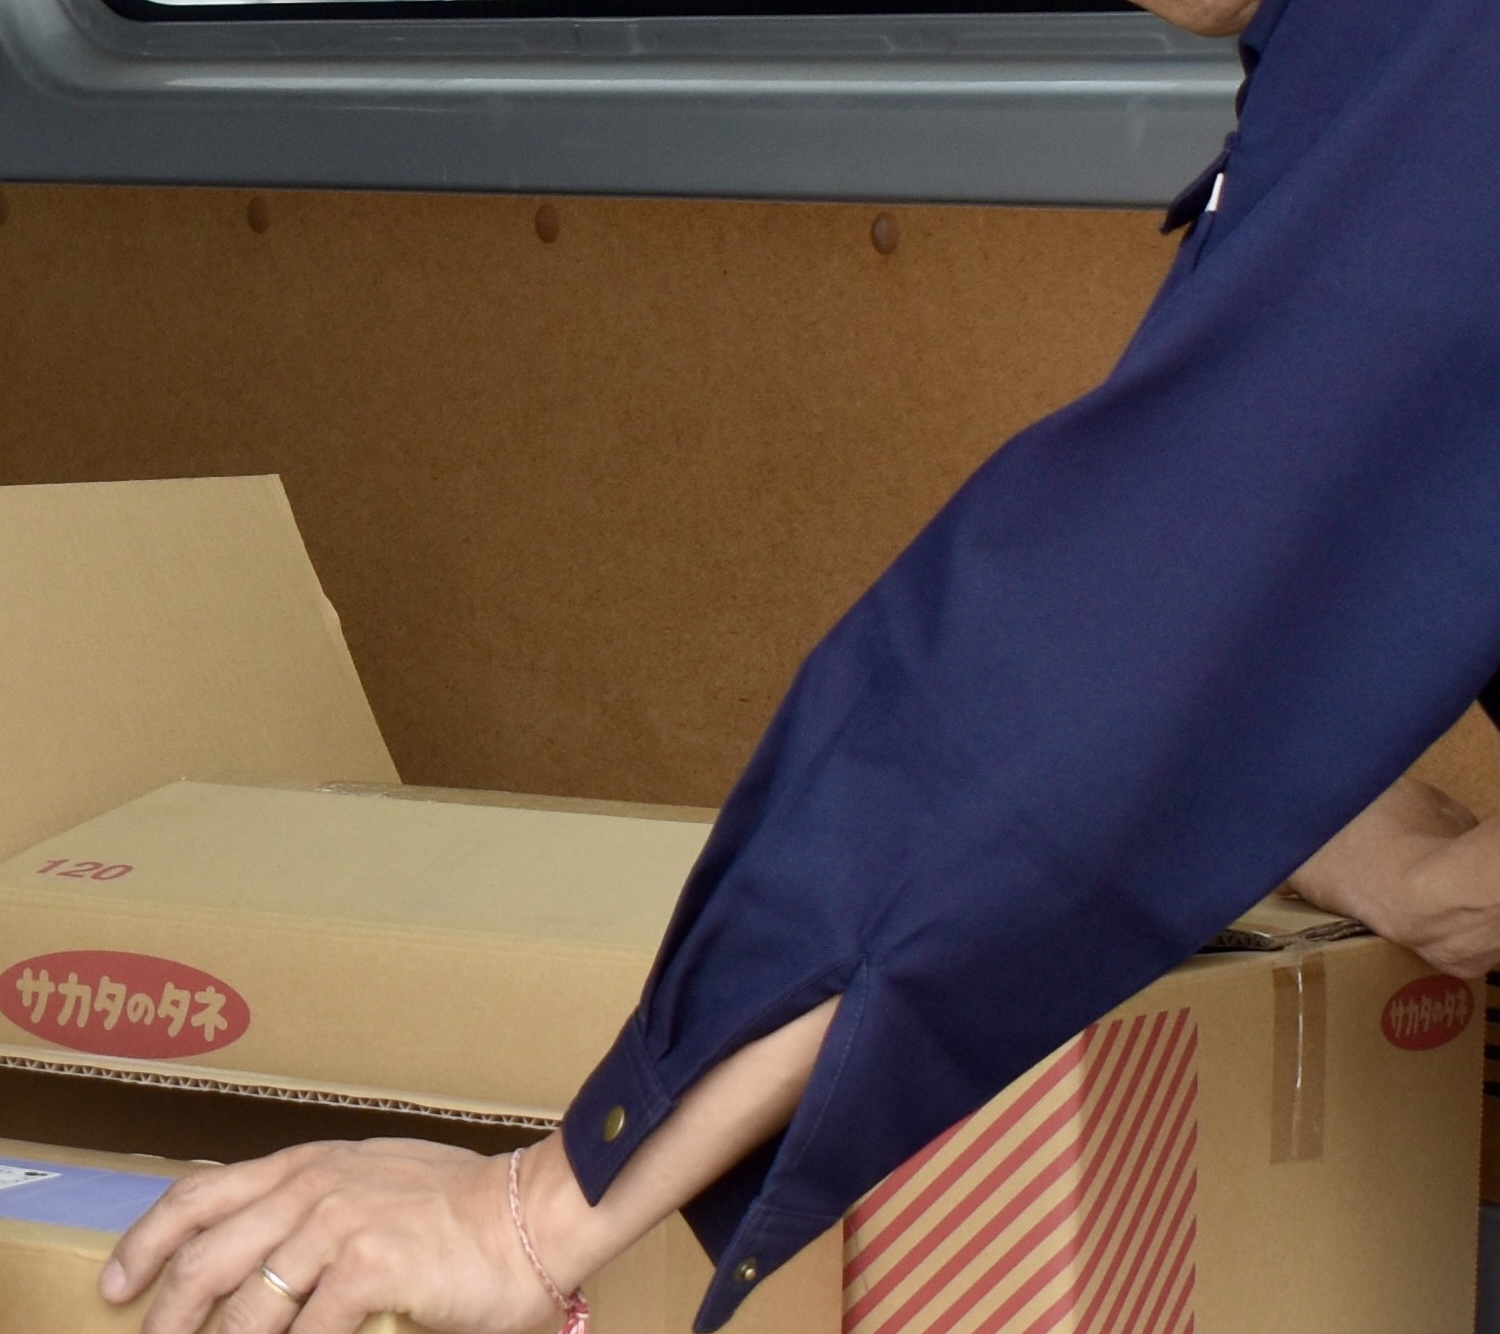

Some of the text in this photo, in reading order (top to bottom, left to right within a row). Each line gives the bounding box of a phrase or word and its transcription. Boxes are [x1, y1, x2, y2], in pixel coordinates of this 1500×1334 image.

[36, 858, 134, 881] 120
[16, 968, 228, 1042] サカタのタネ
[1389, 988, 1468, 1038] サカタのタネ
